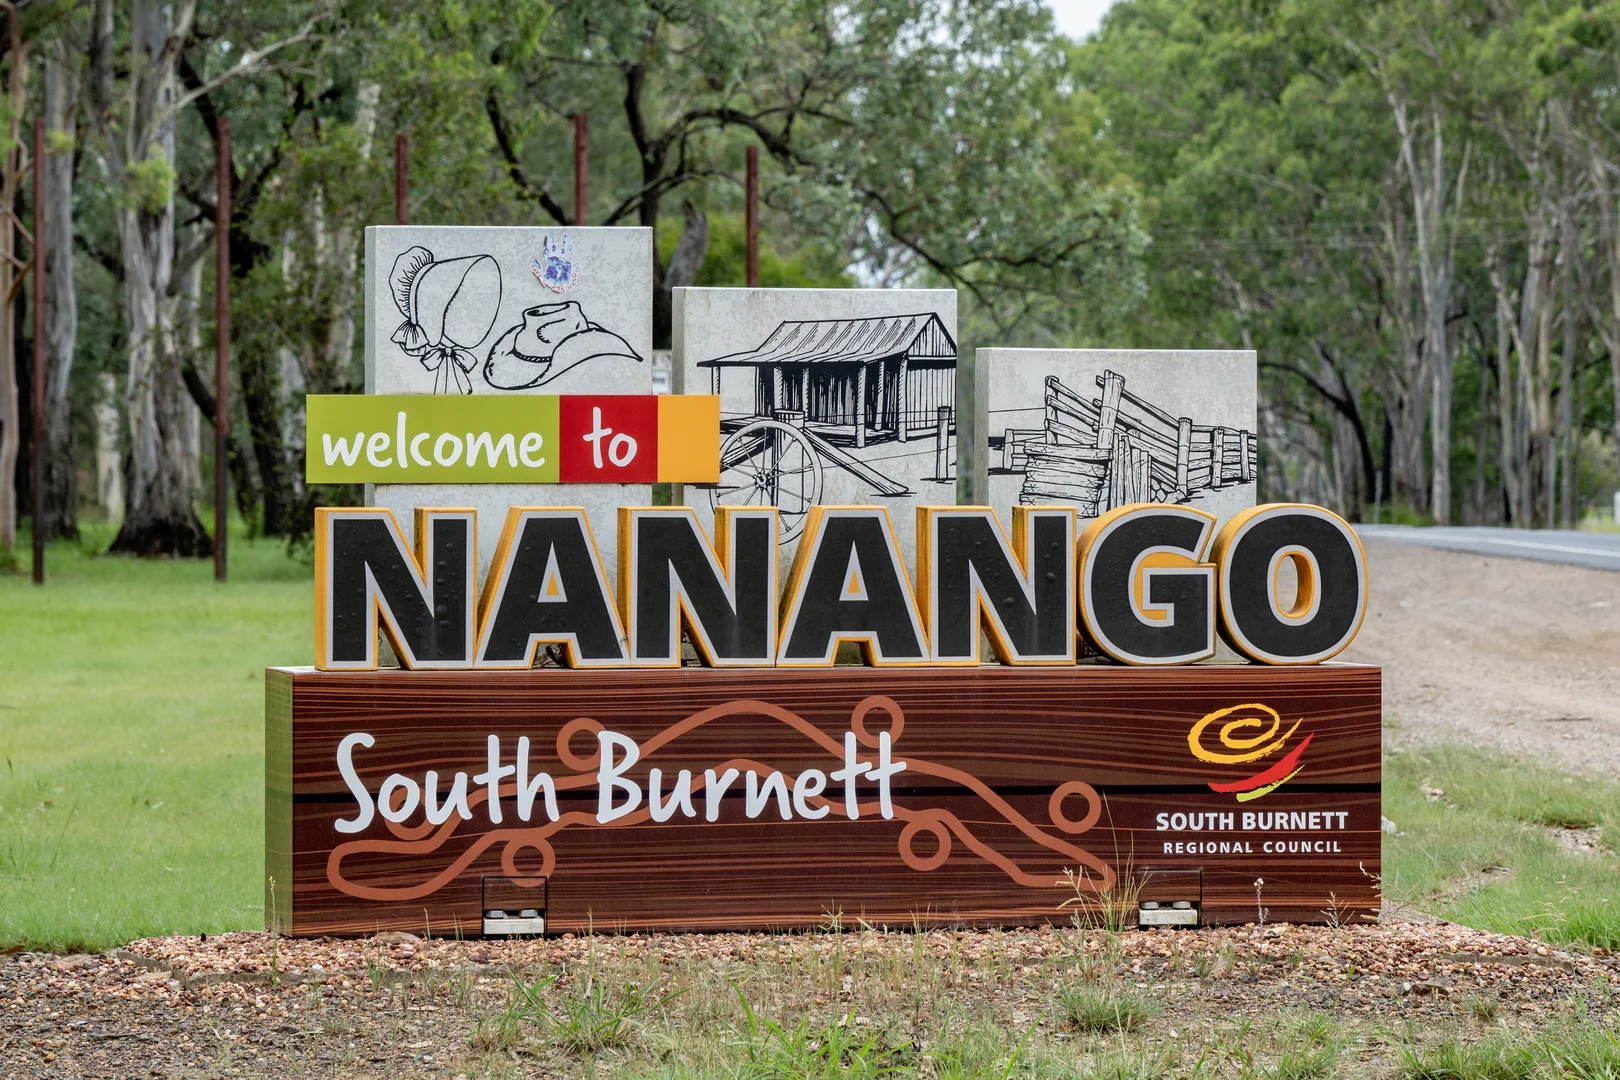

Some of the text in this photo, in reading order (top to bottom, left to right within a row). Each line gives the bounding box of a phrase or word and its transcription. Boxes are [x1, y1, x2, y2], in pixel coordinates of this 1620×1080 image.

[322, 406, 638, 469] welcome to
[314, 503, 1369, 671] NANANGO
[334, 730, 907, 834] South Burnett
[1156, 811, 1349, 831] SOUTH BURNETT
[1163, 840, 1342, 854] REGIONAL COUNCIL
